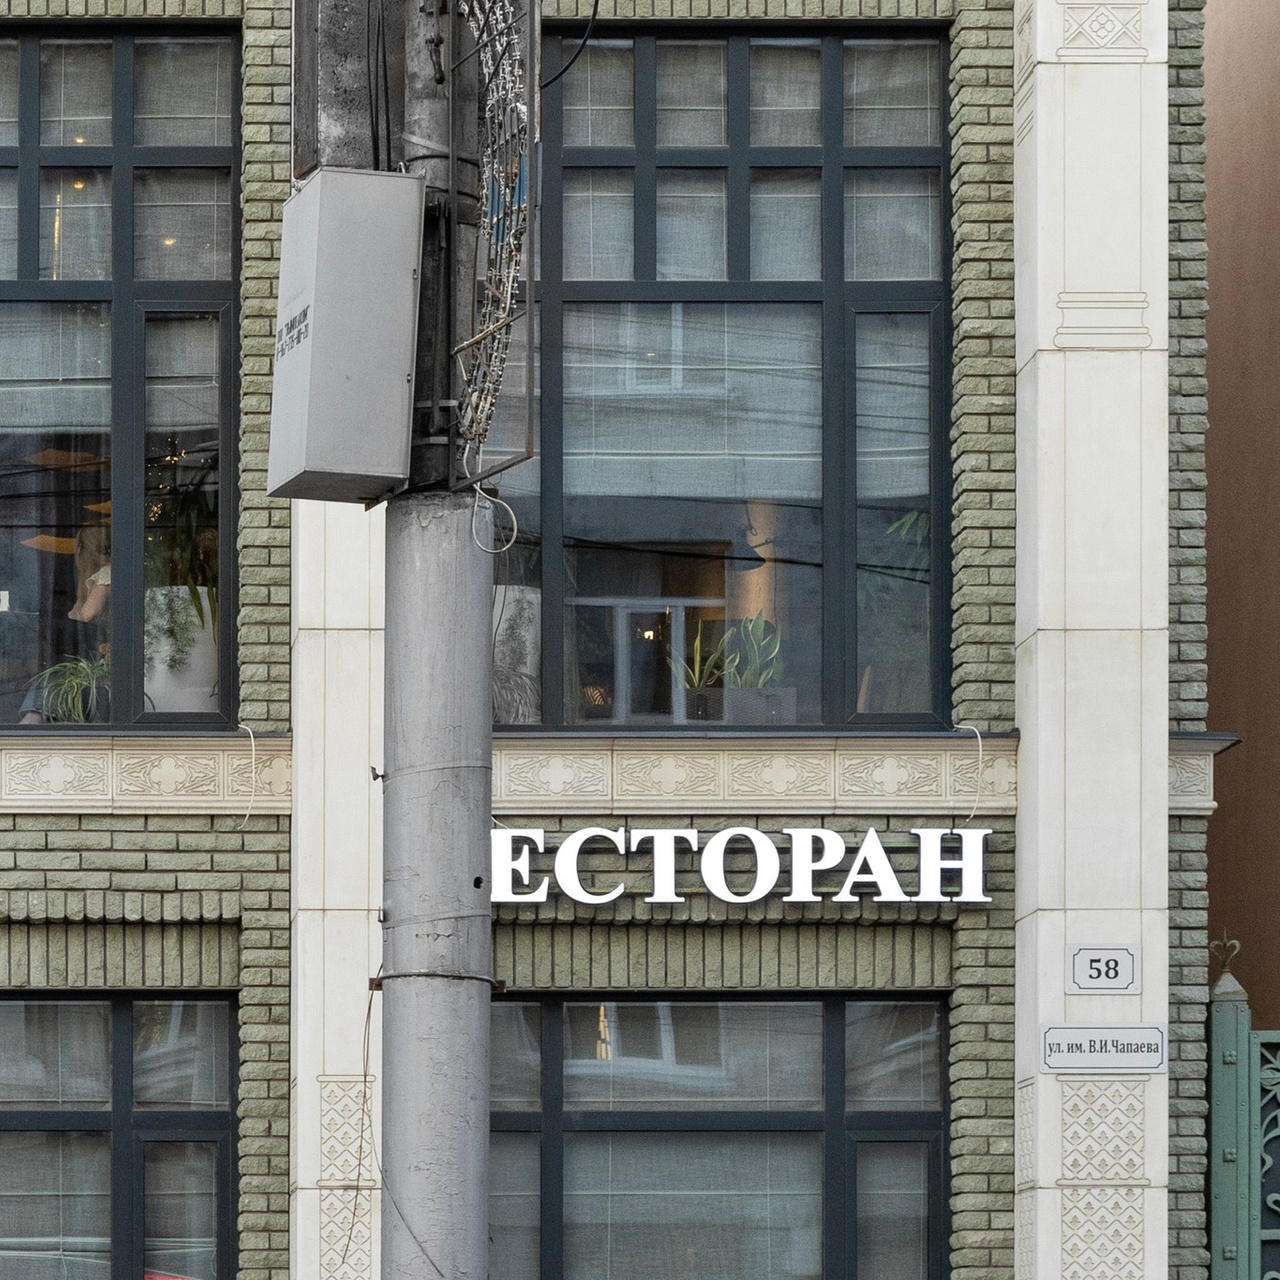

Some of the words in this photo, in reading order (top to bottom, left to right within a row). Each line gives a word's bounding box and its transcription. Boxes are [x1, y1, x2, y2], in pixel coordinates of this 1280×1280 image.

[490, 826, 993, 904] ЕСТОРАН
[1088, 958, 1119, 980] 58
[1048, 1042, 1064, 1057] ул.
[1067, 1042, 1086, 1053] им.
[1089, 1039, 1160, 1054] В.И.Чапаева
